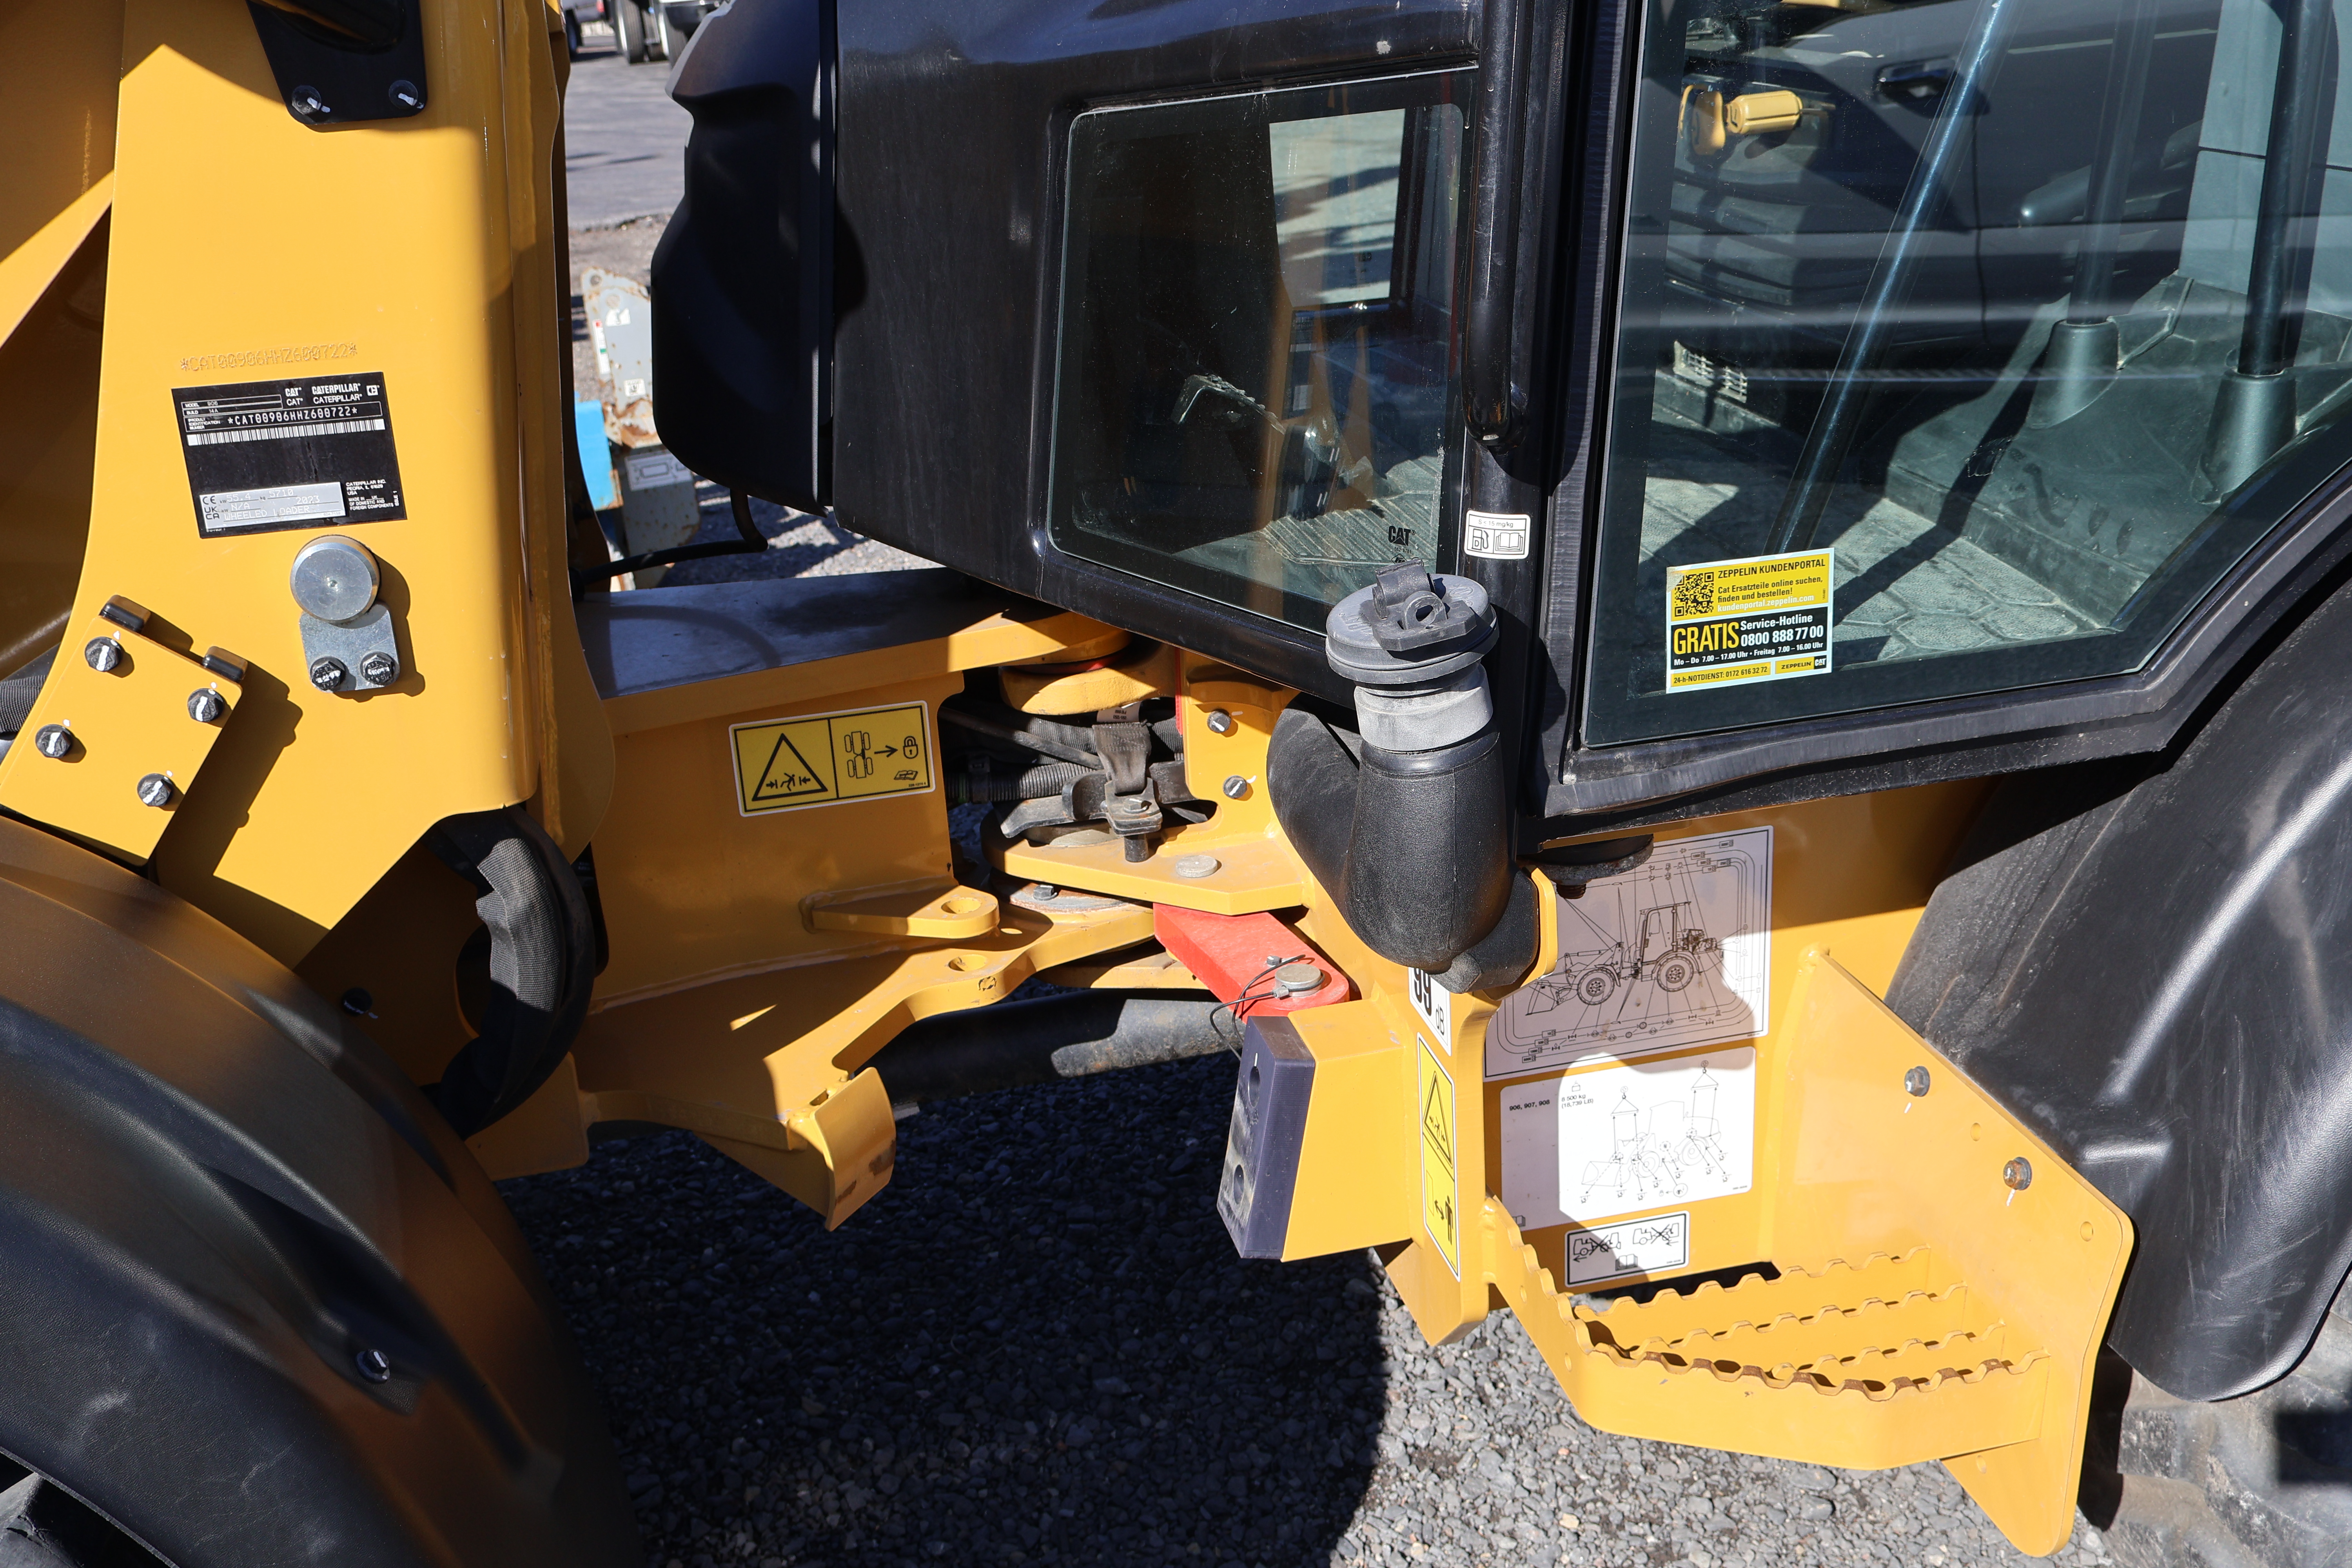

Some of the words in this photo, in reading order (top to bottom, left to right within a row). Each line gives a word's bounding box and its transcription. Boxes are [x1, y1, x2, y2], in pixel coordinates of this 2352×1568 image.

[226, 493, 250, 502] 55.4
[269, 489, 294, 497] 5710
[231, 502, 250, 511] N/A
[296, 495, 320, 505] 2023
[224, 510, 267, 521] WHEELED
[274, 505, 310, 516] LOADER
[1718, 566, 1757, 579] ZEPPELIN
[1759, 559, 1826, 574] KUNDENPORTAL
[1732, 582, 1769, 592] Ersatzteile
[1771, 579, 1793, 588] online
[1795, 576, 1823, 584] suchen,
[1717, 595, 1814, 612] kundenportal.zeppelin.com
[1718, 595, 1740, 603] finden
[1757, 588, 1793, 598] bestellen!
[1673, 621, 1739, 655] GRATIS
[1740, 614, 1813, 630] Service-Hotline
[1740, 632, 1769, 647] 0800
[1674, 671, 1724, 683] 24-h-NOTDIENST:
[1414, 968, 1432, 1016] 99
[1436, 1004, 1445, 1036] dB
[1561, 1100, 1582, 1109] (18,739
